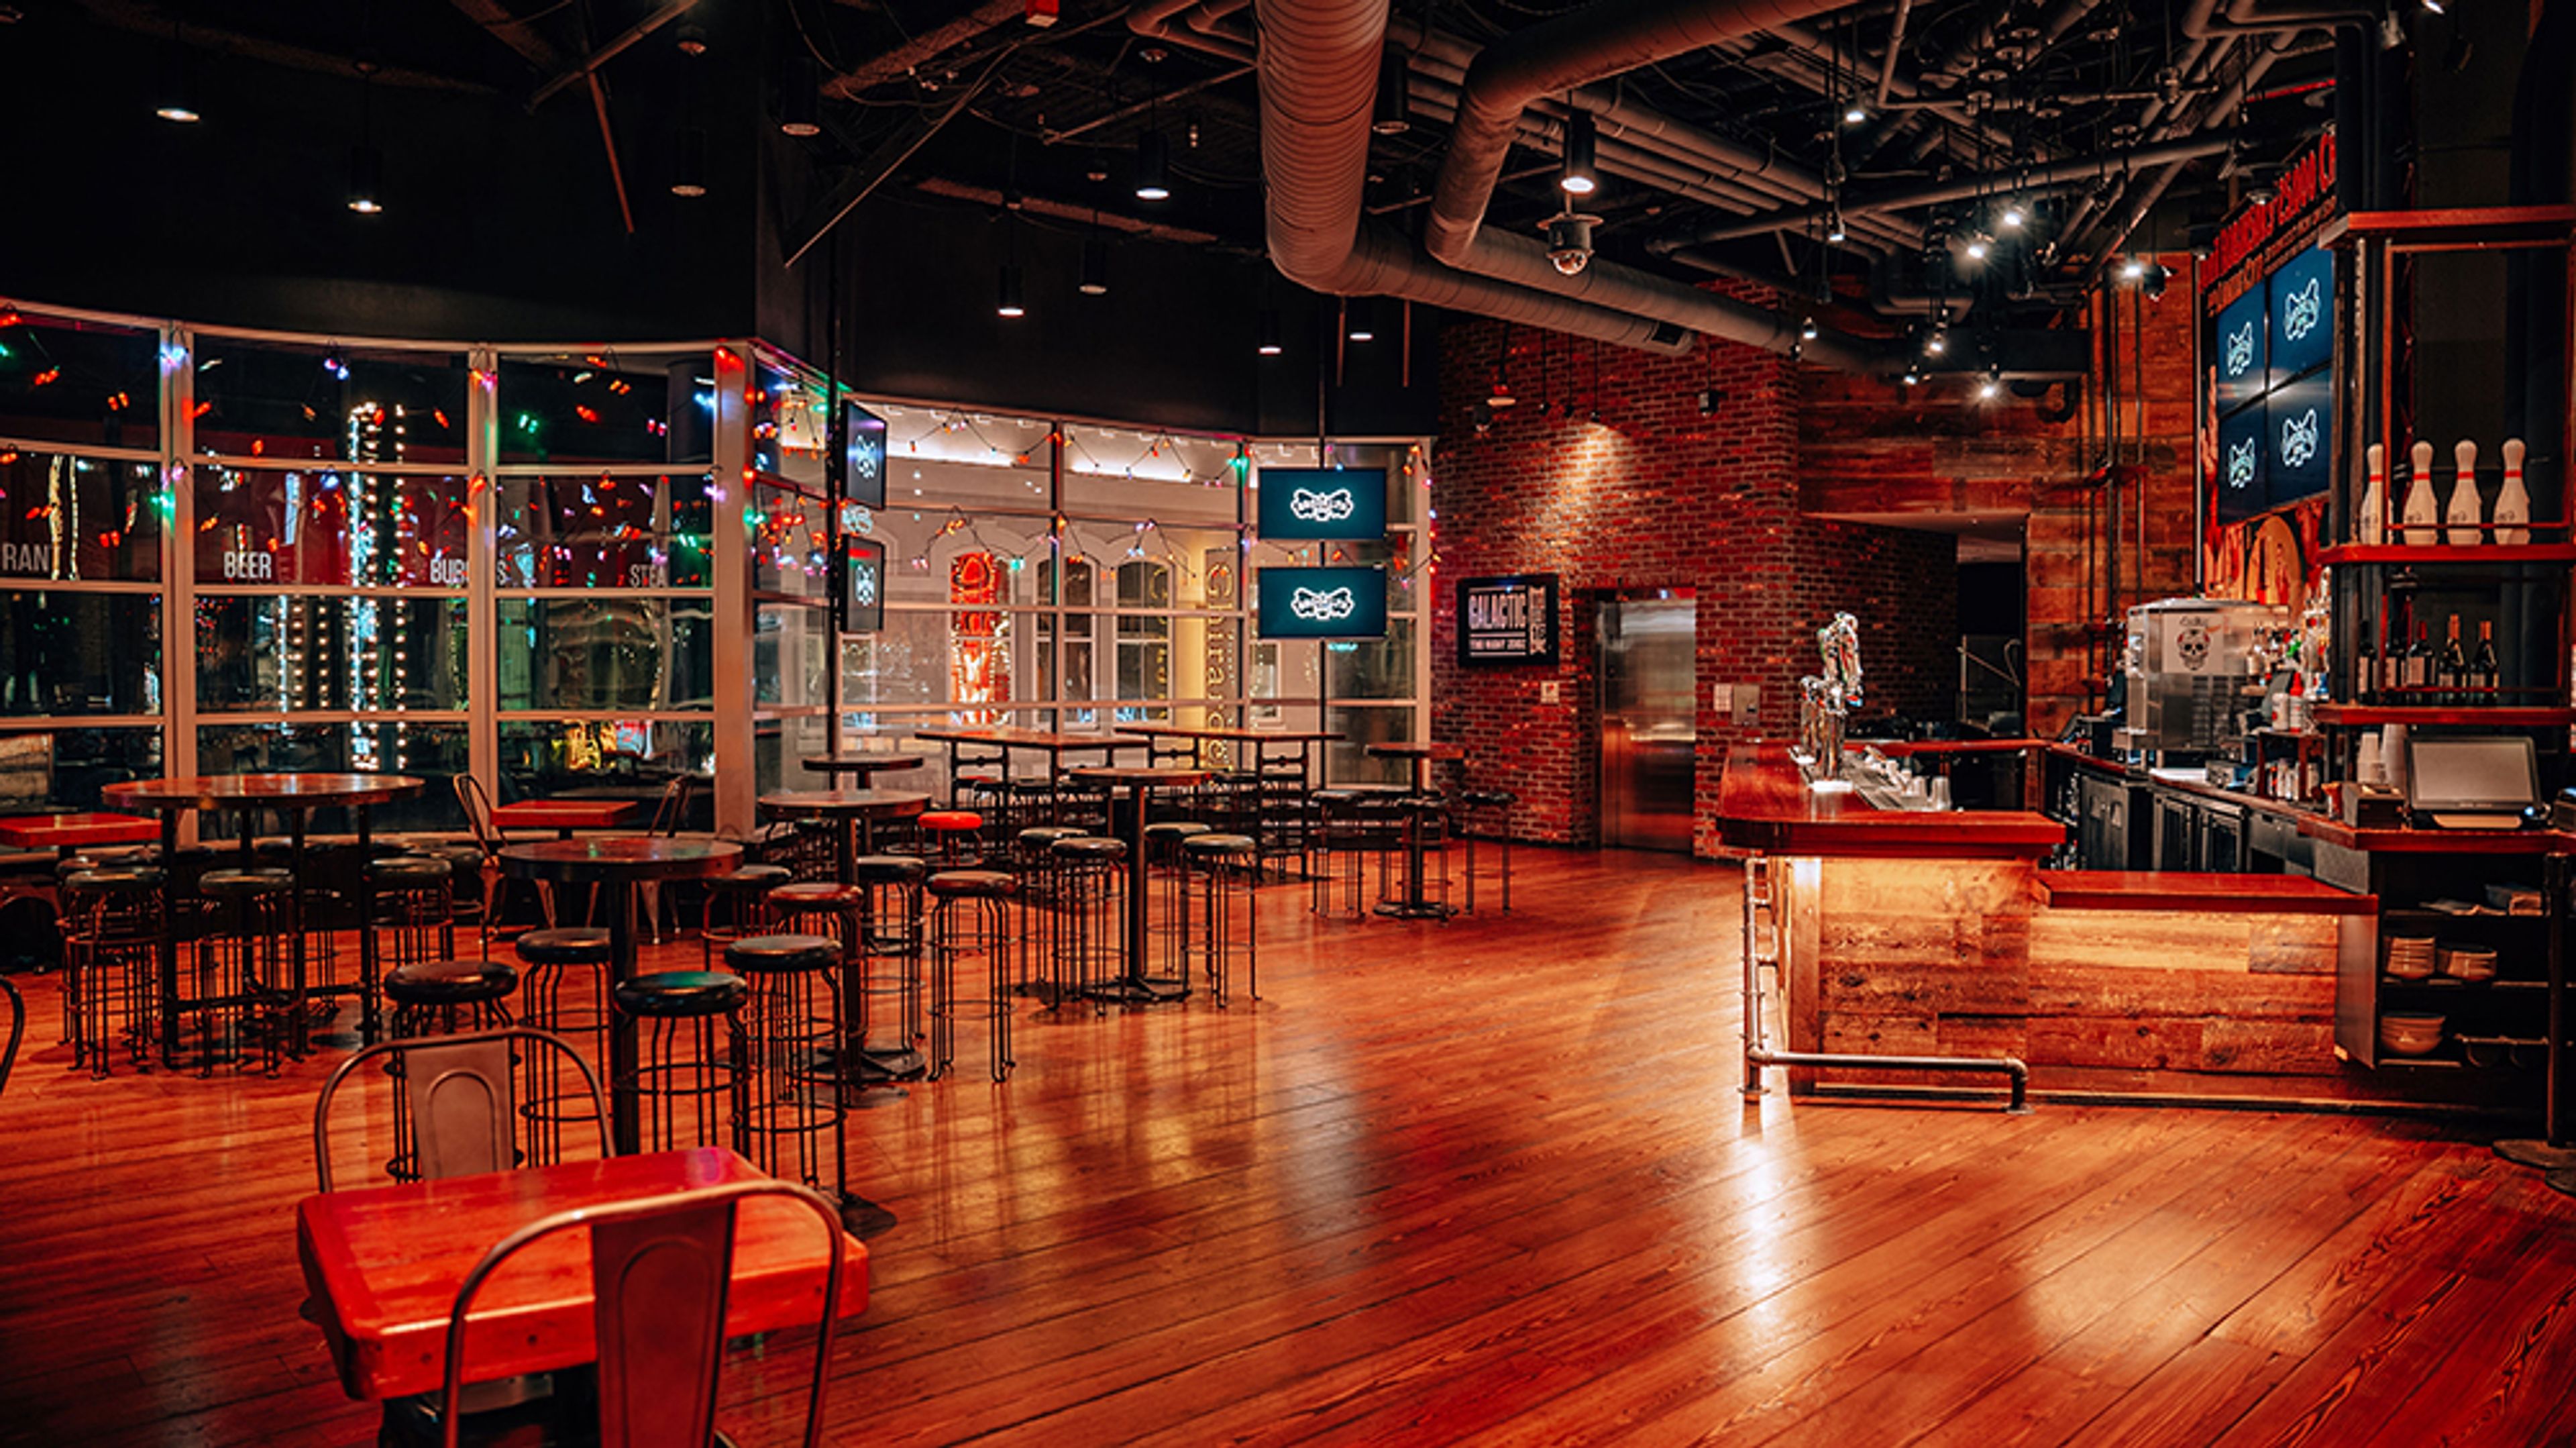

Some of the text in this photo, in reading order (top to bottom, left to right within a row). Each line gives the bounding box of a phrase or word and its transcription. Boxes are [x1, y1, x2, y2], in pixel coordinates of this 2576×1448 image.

[223, 551, 272, 578] BEER
[630, 564, 668, 588] STEA
[1468, 593, 1526, 629] GALACTIC
